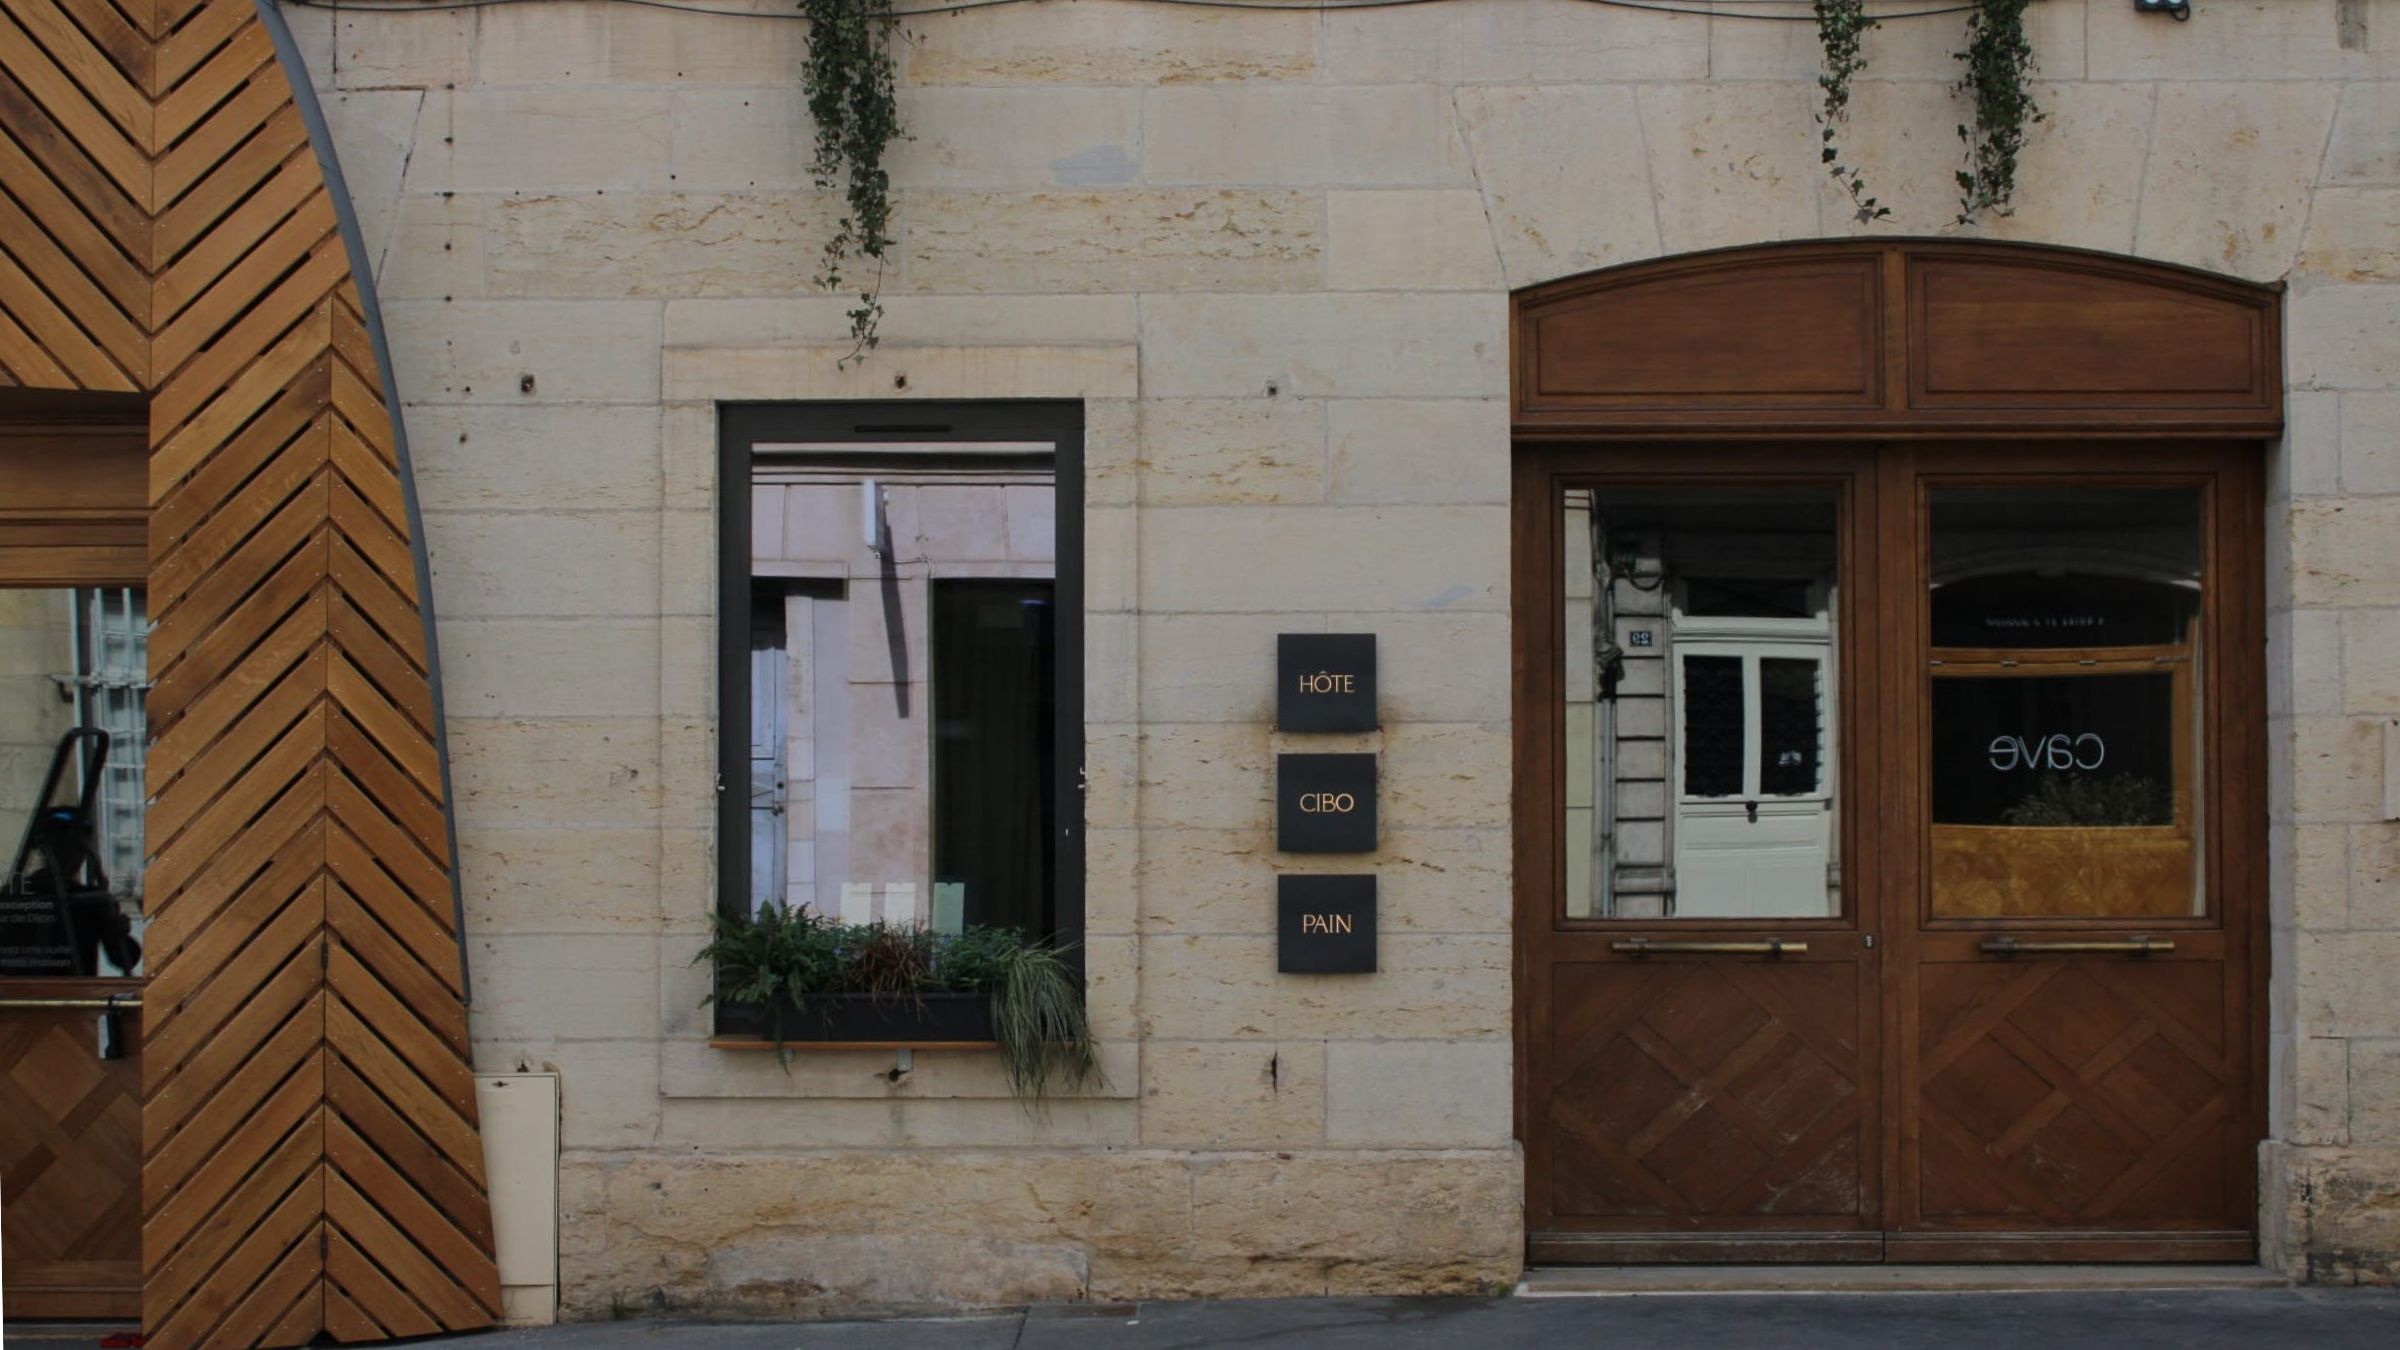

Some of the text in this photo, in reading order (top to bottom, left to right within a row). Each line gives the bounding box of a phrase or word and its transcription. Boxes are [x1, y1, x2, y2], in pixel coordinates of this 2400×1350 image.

[1299, 670, 1355, 693] HÔTE
[1299, 793, 1355, 813] CIBO
[1302, 914, 1352, 933] PAIN
